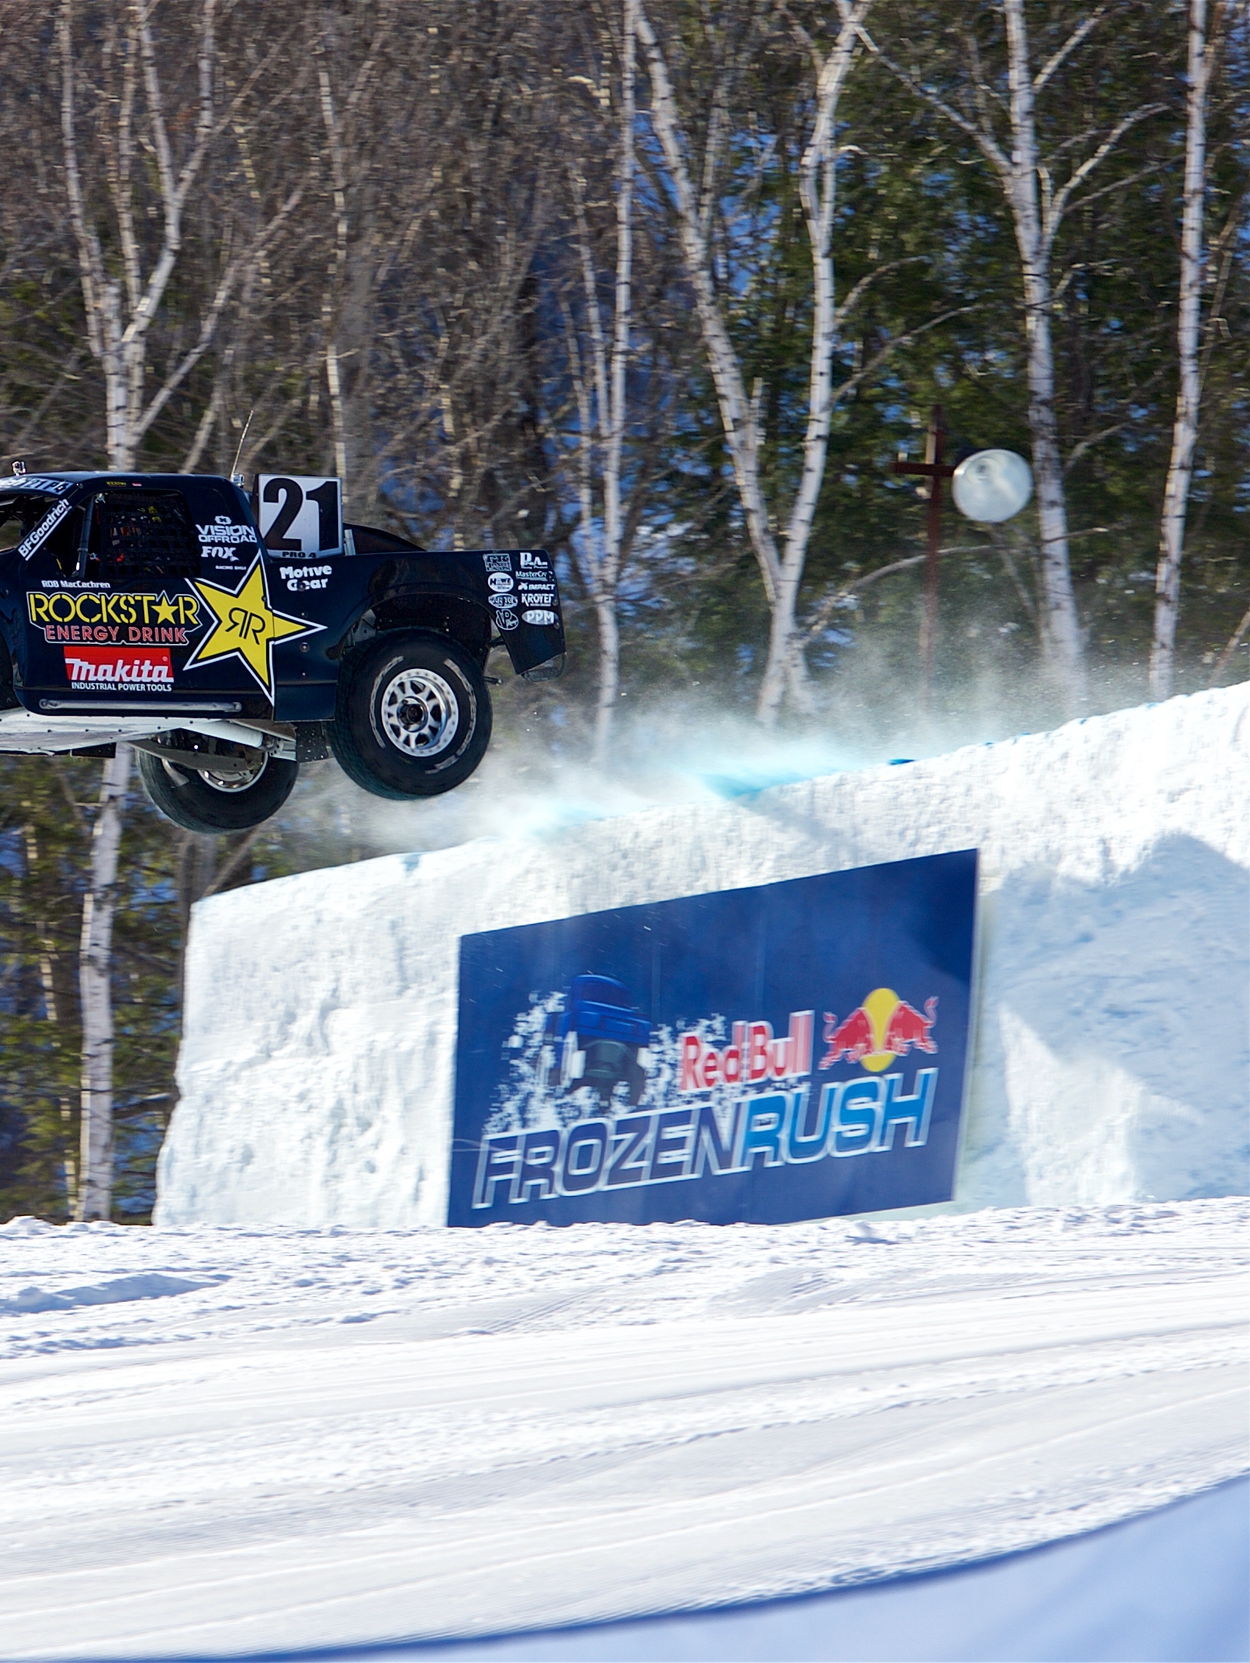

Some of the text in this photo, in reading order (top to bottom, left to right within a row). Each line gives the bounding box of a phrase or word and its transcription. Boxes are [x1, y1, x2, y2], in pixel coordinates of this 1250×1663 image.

[263, 477, 339, 551] 21
[17, 498, 69, 558] BFGoodrich
[195, 524, 256, 536] VISION
[198, 534, 258, 544] OFFROAD
[200, 545, 240, 562] FOX
[279, 565, 333, 579] Motive
[41, 580, 58, 588] ROB
[526, 610, 555, 624] PPM
[45, 625, 186, 643] ENERGY DRINK
[71, 682, 172, 692] INDUSTRIAL POWER TOOLS
